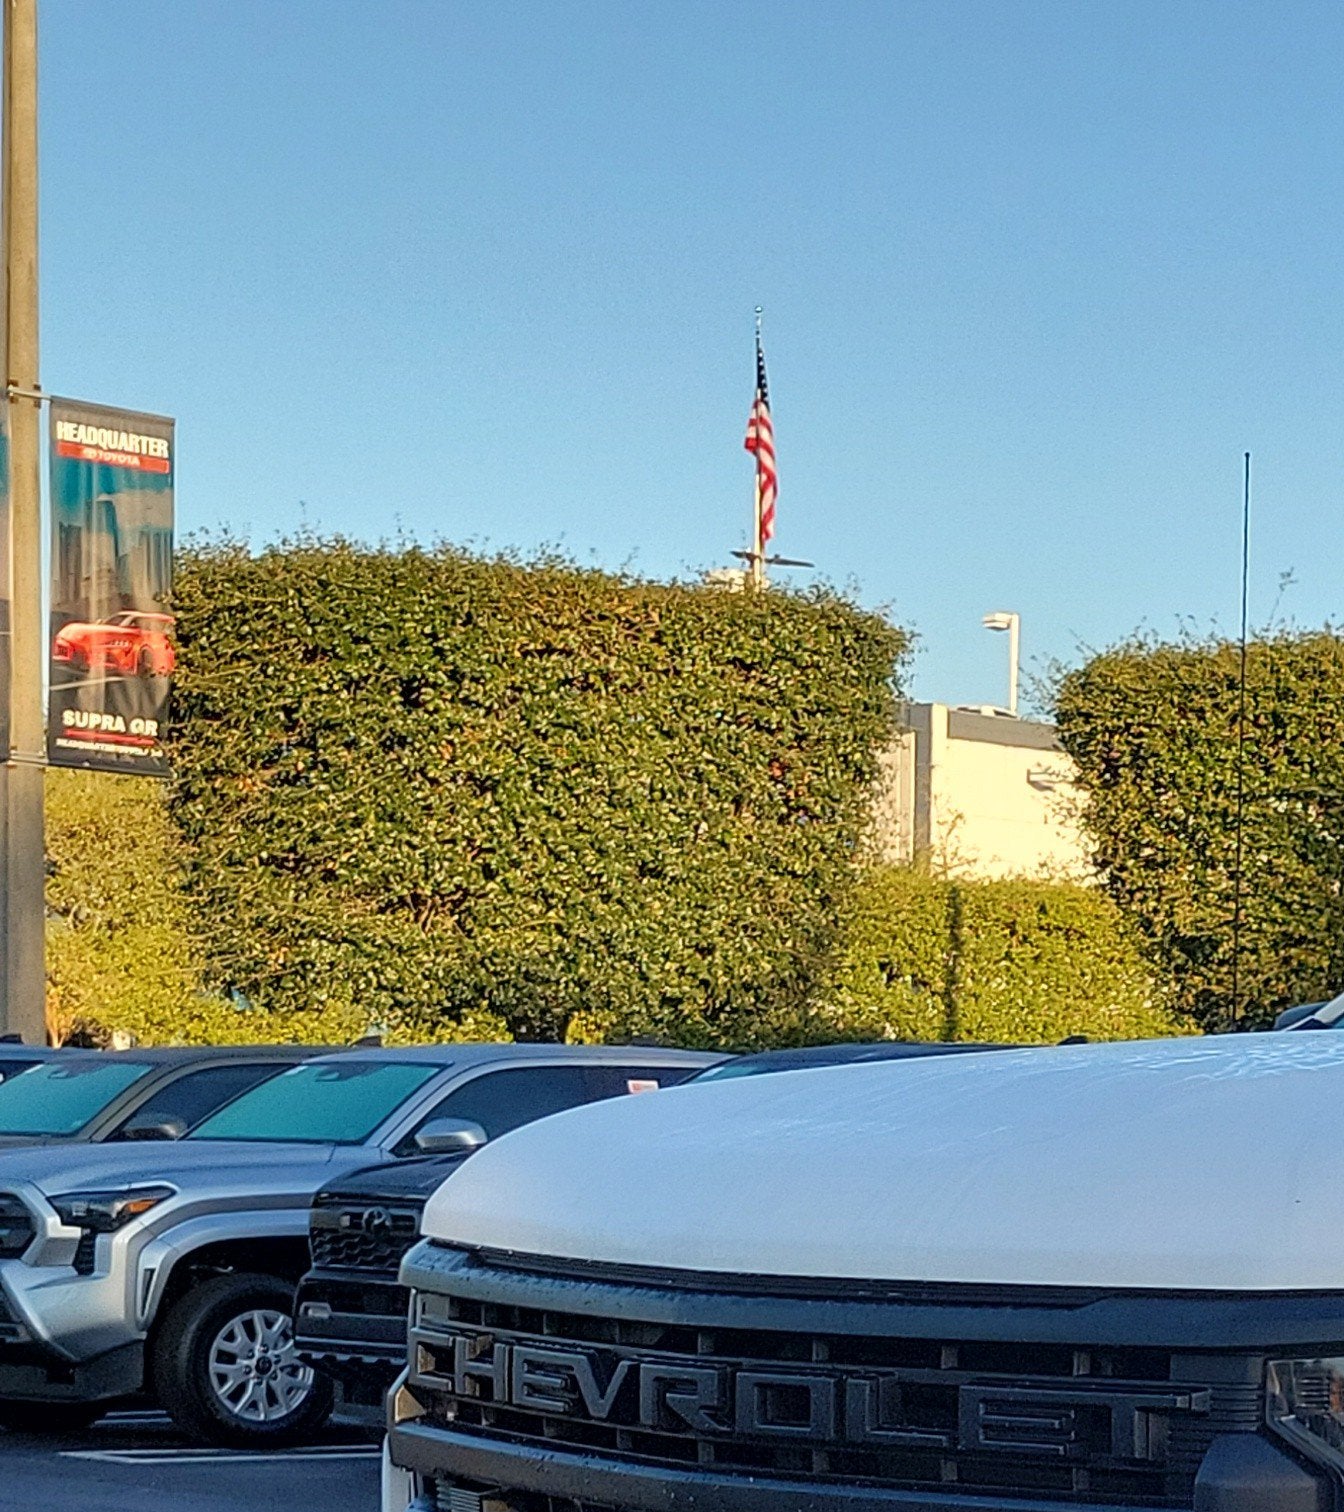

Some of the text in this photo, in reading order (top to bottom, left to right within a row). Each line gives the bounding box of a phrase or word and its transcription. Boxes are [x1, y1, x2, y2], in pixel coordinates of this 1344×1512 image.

[56, 421, 169, 458] HEADQUARTER
[99, 450, 141, 466] TOYOTA
[62, 709, 126, 733] SUPRA
[408, 1326, 1211, 1460] CHEVROLET
